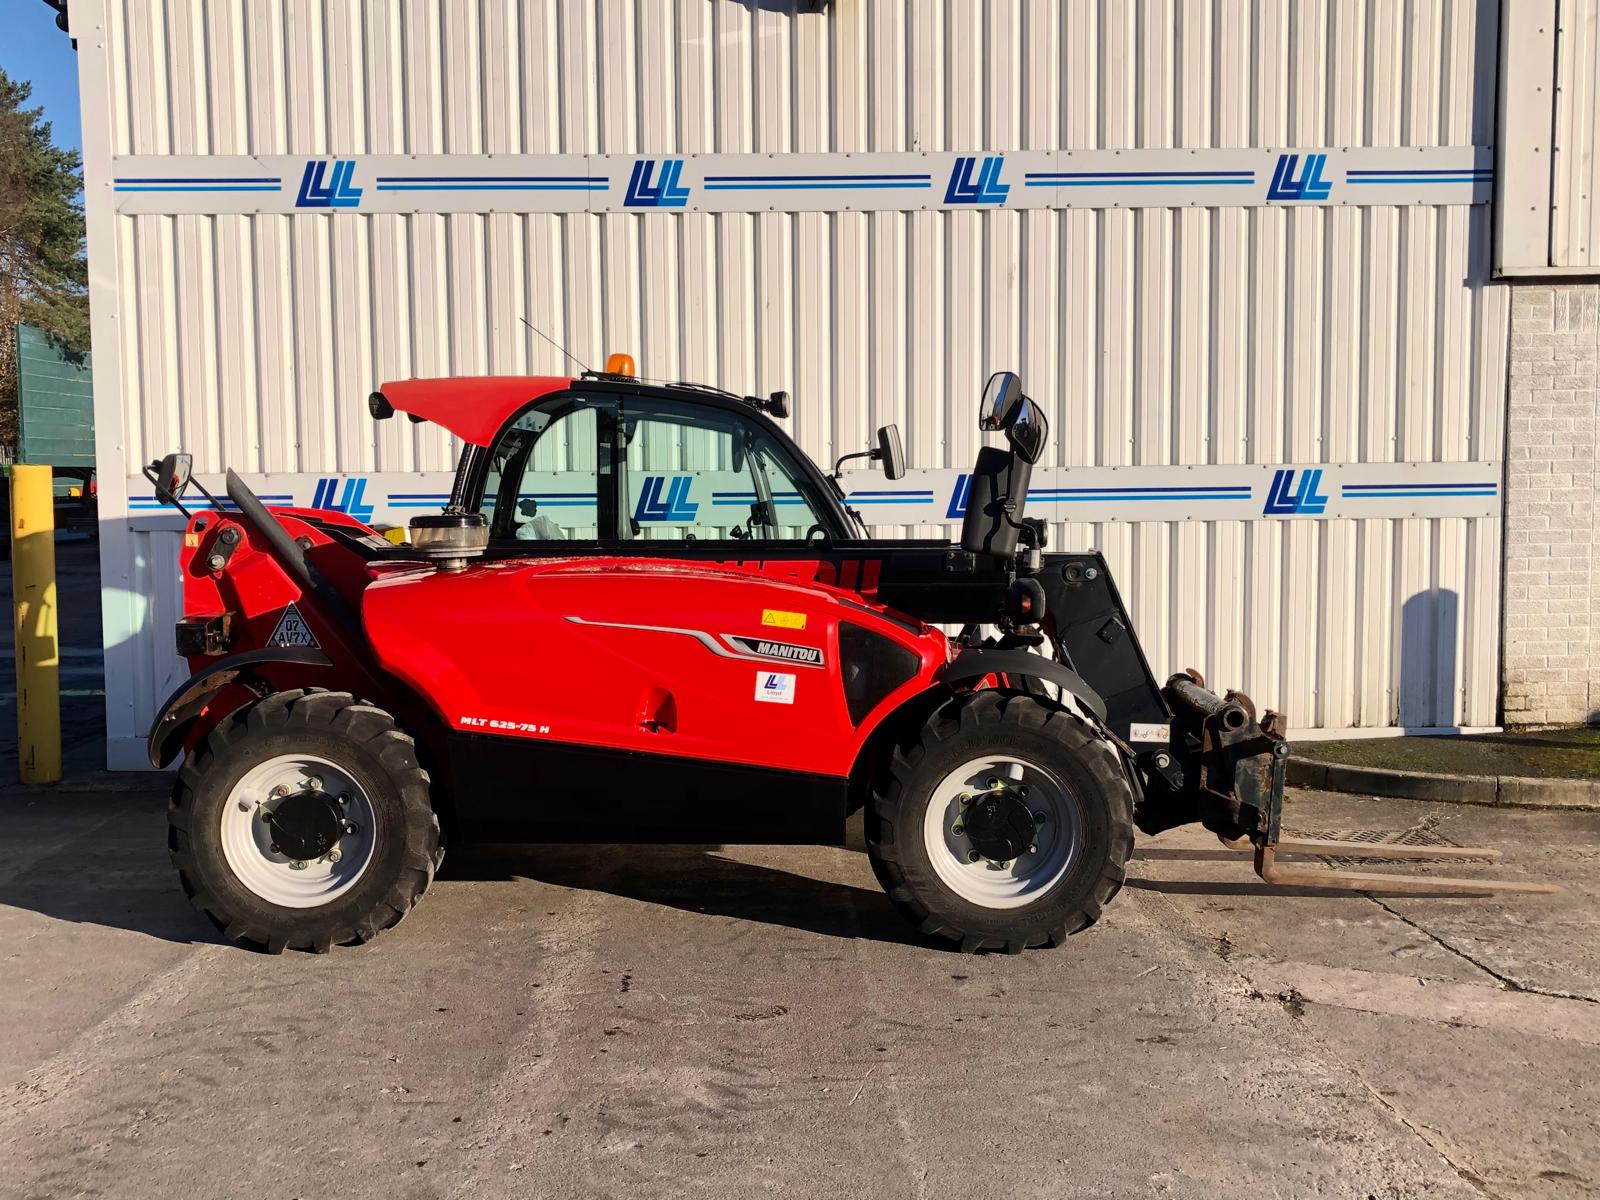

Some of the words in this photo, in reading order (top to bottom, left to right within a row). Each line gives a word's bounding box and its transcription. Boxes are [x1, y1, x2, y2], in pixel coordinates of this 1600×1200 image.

[278, 632, 308, 643] AV7X
[757, 642, 817, 660] MANITOU
[460, 716, 488, 727] MLT
[489, 720, 537, 732] 625-75
[539, 725, 550, 734] H
